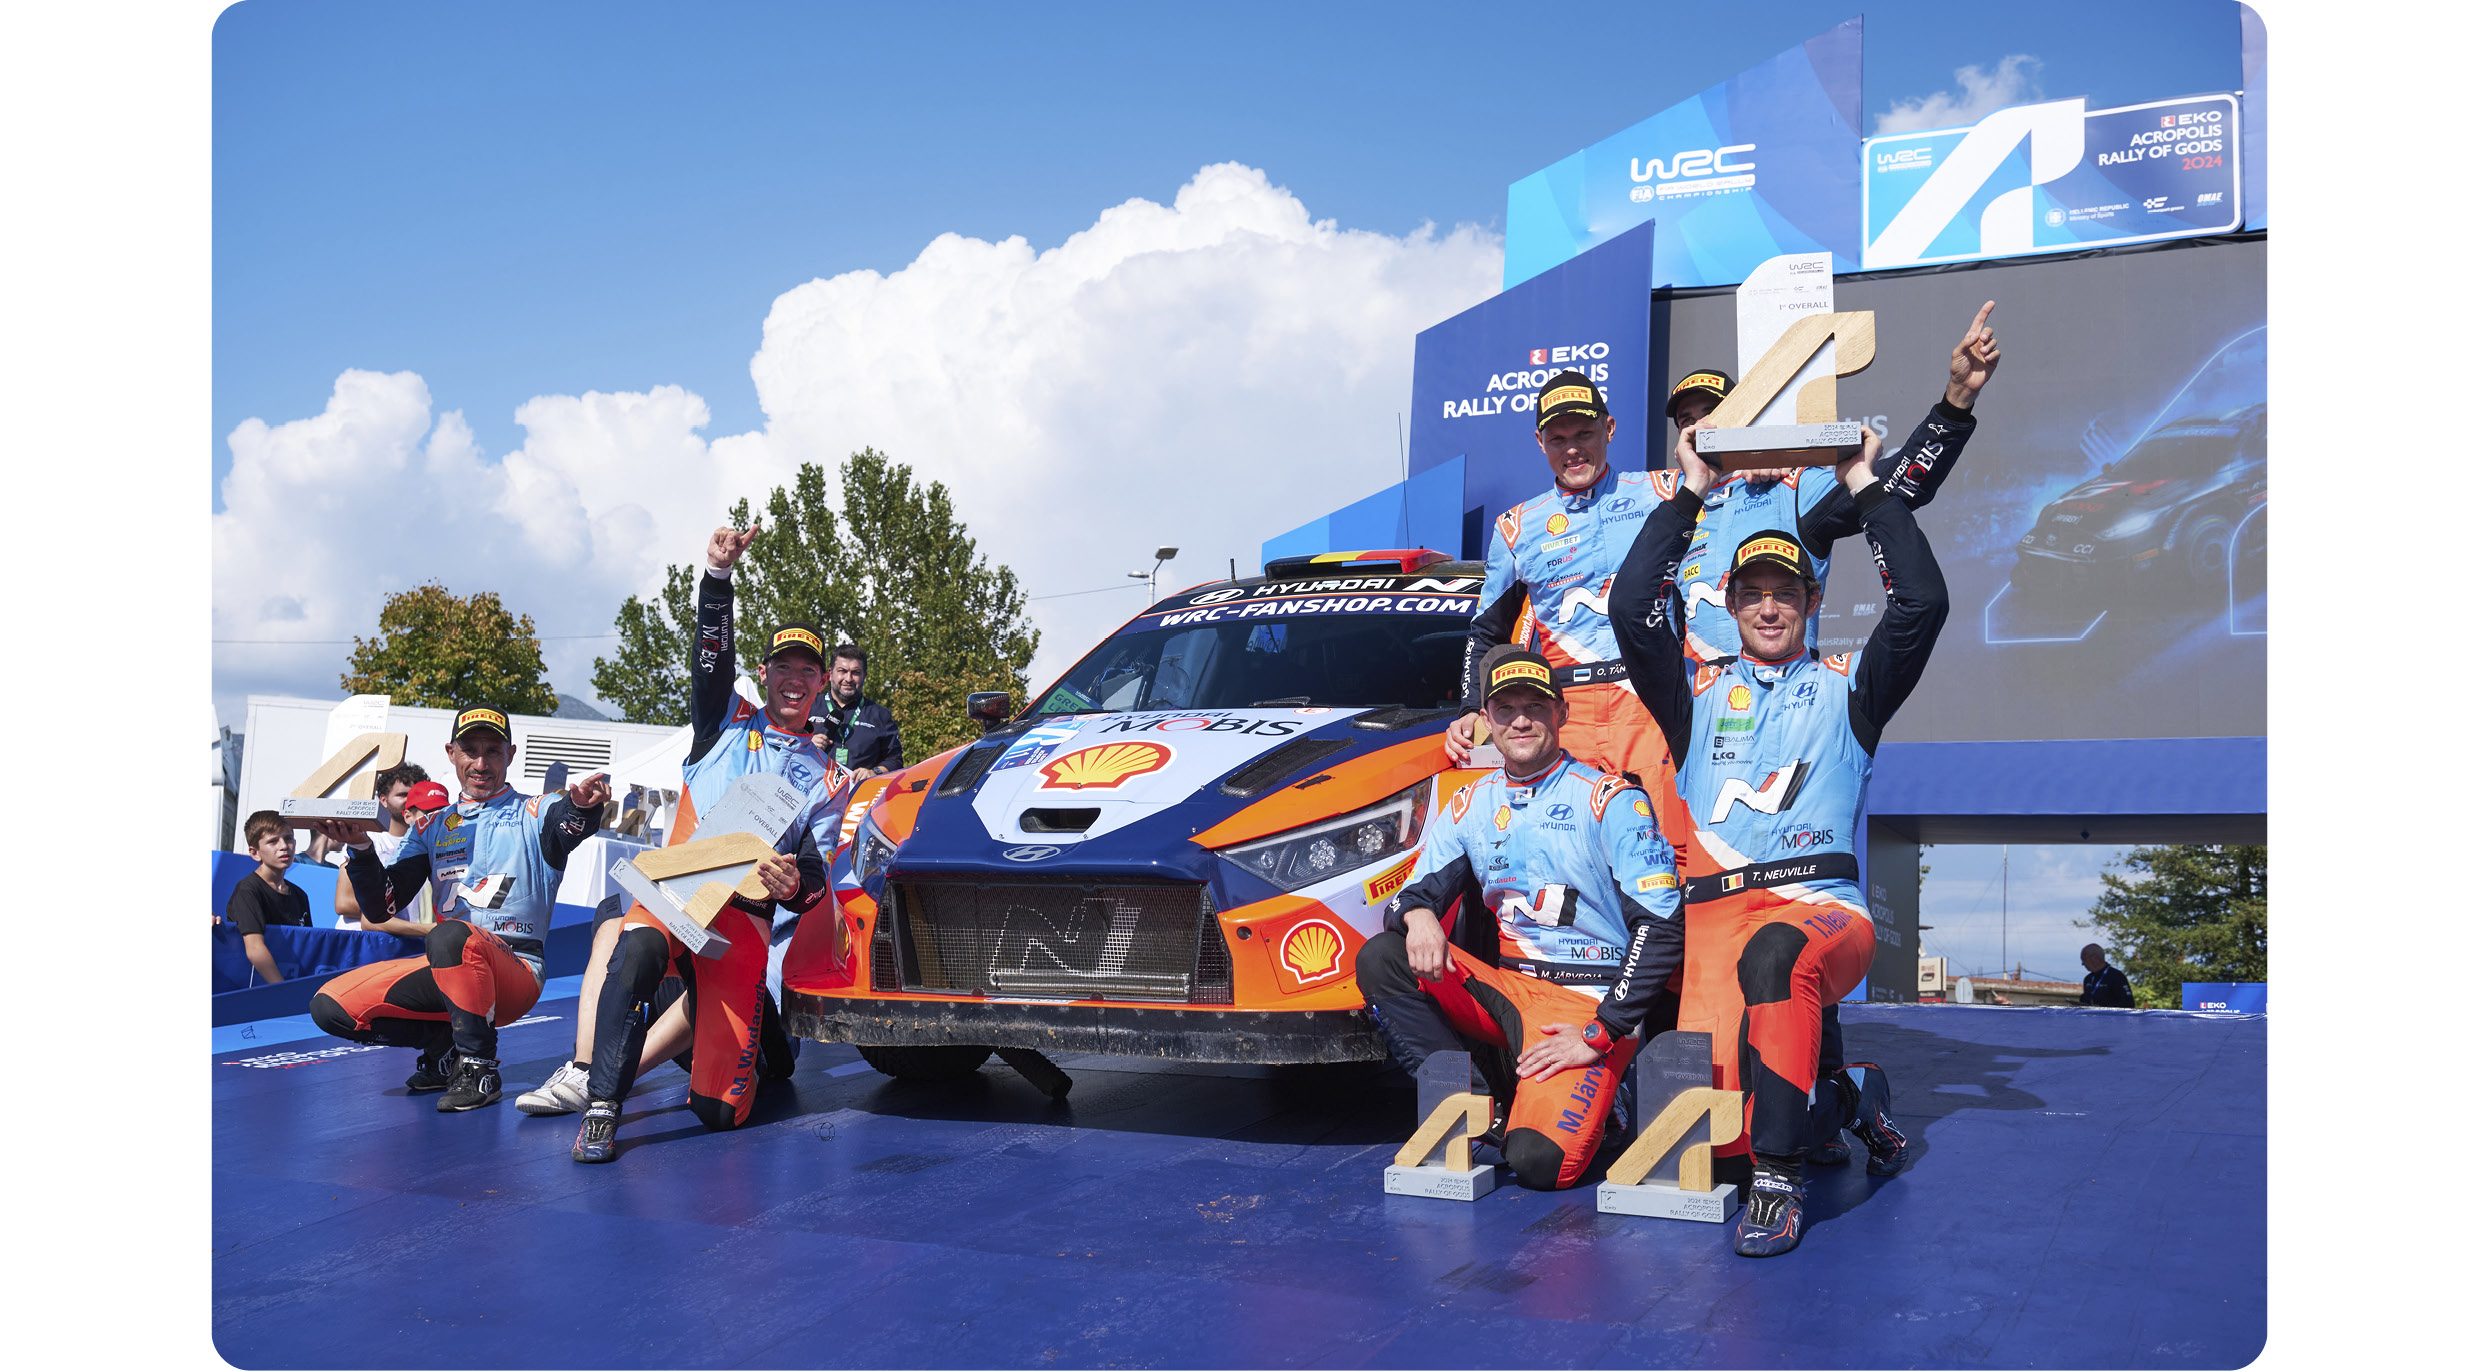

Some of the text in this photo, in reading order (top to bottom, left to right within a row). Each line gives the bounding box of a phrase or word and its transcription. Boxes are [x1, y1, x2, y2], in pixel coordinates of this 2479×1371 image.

[2178, 111, 2222, 126] EKO
[2130, 124, 2222, 147] ACROPOLIS
[1877, 147, 1932, 165] WRC
[2098, 139, 2223, 166] RALLY OF GODS
[1630, 143, 1756, 182] WRC
[2182, 155, 2223, 170] 2024
[1630, 186, 1655, 203] FIA
[1658, 186, 1753, 201] CHAMPIONSHIP
[2099, 203, 2130, 212] REPUBLIC
[1789, 261, 1824, 271] WRC
[1788, 301, 1829, 310] OVERALL
[1551, 342, 1610, 363] EKO
[1543, 388, 1588, 408] PIRELLI
[1443, 396, 1507, 419] RALLY
[1897, 439, 1944, 498] MOBIS
[1602, 510, 1645, 526] HYUNDAI
[1542, 535, 1579, 551] VIVATBET
[1741, 540, 1796, 560] PIRELLI
[1547, 555, 1573, 568] FORUS
[1684, 565, 1699, 579] RACC
[1253, 578, 1396, 598] HYUNDAI
[1159, 598, 1472, 627] WRC-FANSHOP.COM
[721, 614, 729, 652] HYUNDAI
[777, 630, 821, 649] PIRELLI
[701, 624, 720, 674] MOBIS
[1495, 665, 1546, 681] PIRELLI
[1597, 663, 1626, 676] O. TÄN
[1054, 693, 1079, 712] GRE
[461, 711, 504, 725] PIRELLI
[1101, 711, 1233, 722] HYUNDAI
[1098, 717, 1304, 736] MOBIS
[1712, 751, 1736, 760] LKQ
[776, 786, 800, 808] WRC
[753, 814, 779, 838] OVERALL
[1540, 822, 1576, 832] HYUNDA
[1771, 822, 1812, 836] HYUNDAI
[1781, 829, 1834, 850] MOBIS
[1368, 856, 1418, 900] PIREL
[1752, 864, 1817, 881] T. NEUVILLE
[1641, 876, 1676, 889] PIRELLI
[493, 921, 534, 934] MOBIS
[1558, 938, 1598, 946] HYUNDAI
[1571, 946, 1623, 961] MOBIS
[1541, 970, 1552, 979] M.
[1676, 1072, 1708, 1080] OVERALL
[1436, 1184, 1470, 1192] ACROPOLIS
[1669, 1209, 1690, 1217] RALLY
[1701, 1212, 1721, 1220] GODS
[1683, 1204, 1721, 1212] ACROPOLIS
